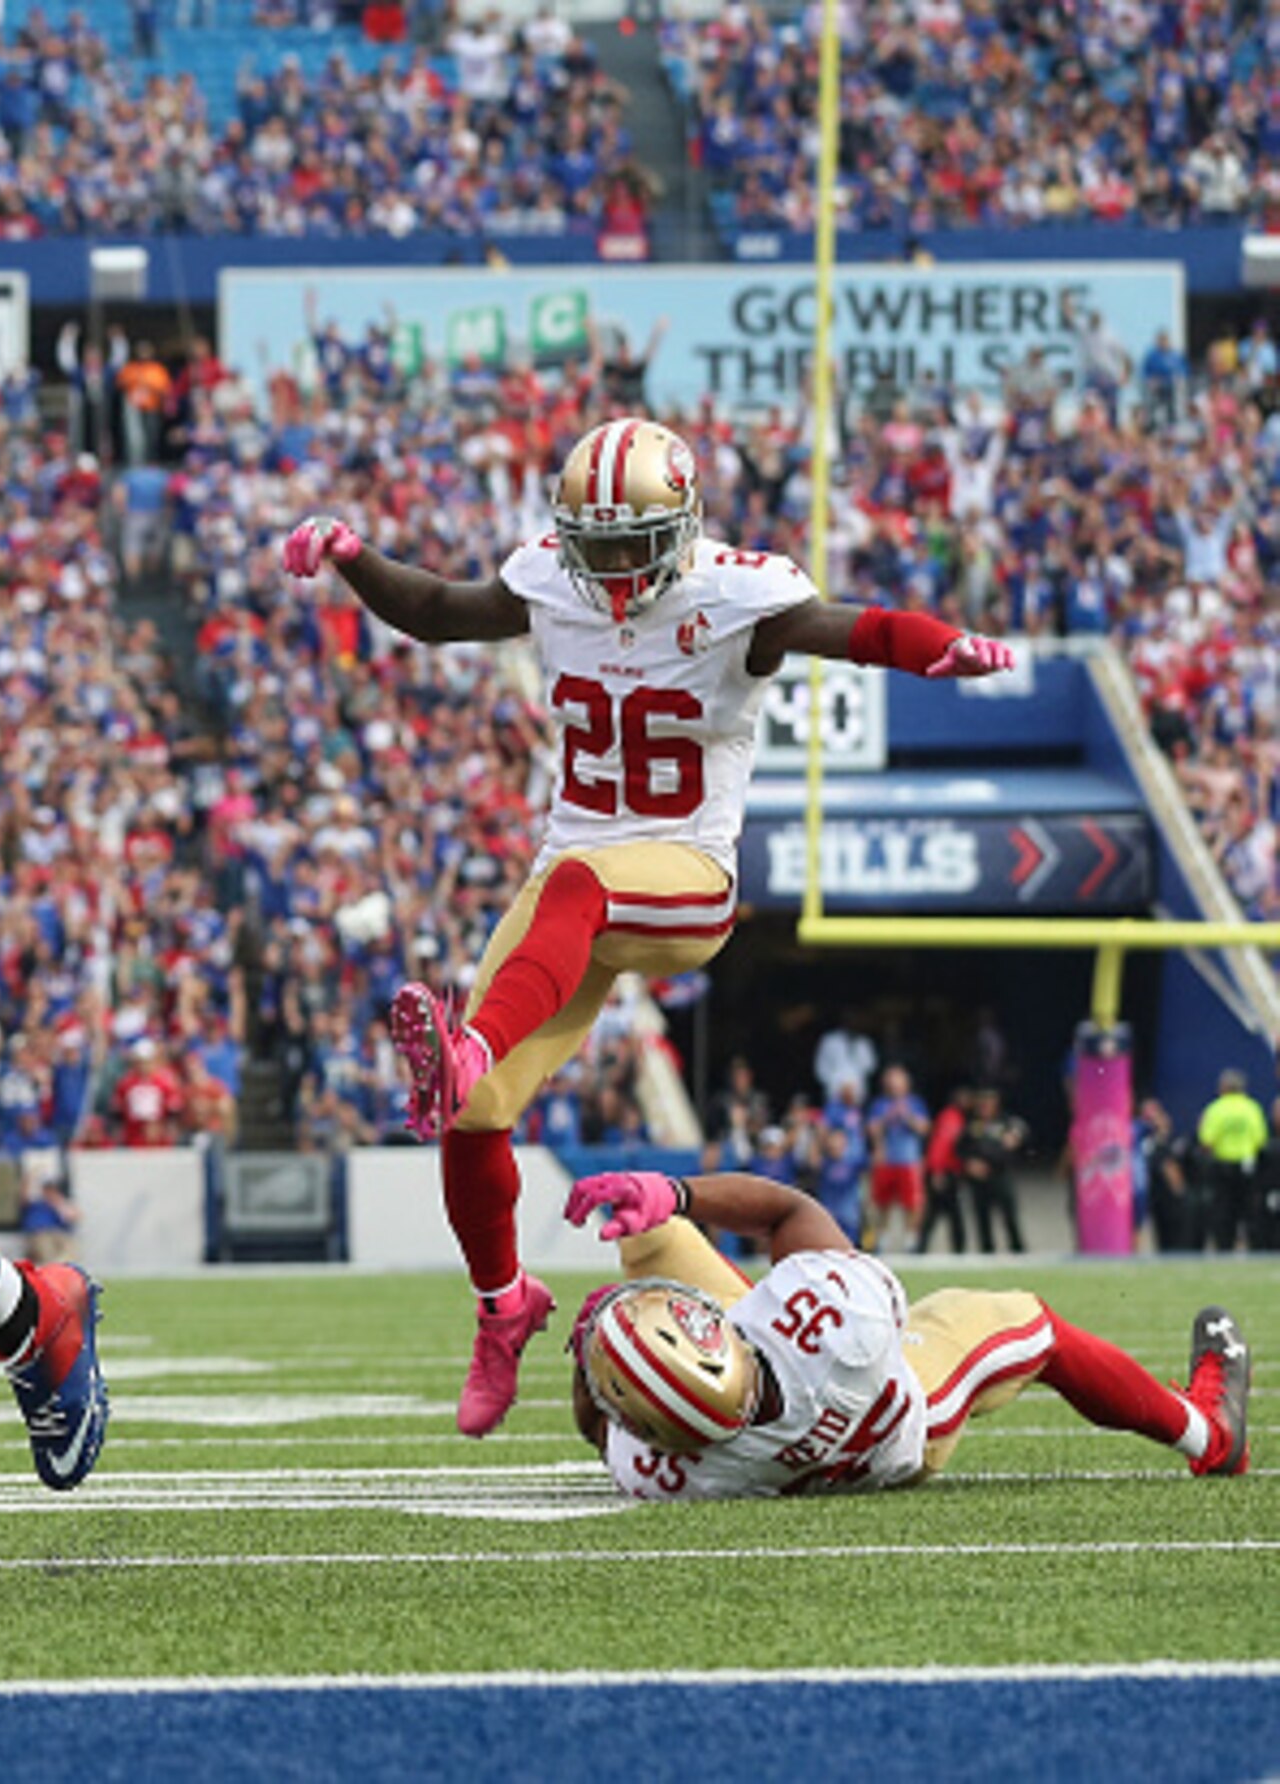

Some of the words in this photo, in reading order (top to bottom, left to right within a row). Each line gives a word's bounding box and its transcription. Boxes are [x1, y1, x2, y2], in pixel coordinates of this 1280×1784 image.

[763, 674, 864, 750] 40
[552, 673, 705, 819] 26
[767, 829, 979, 894] BILLS
[771, 1288, 843, 1355] 35
[772, 1407, 851, 1471] REID
